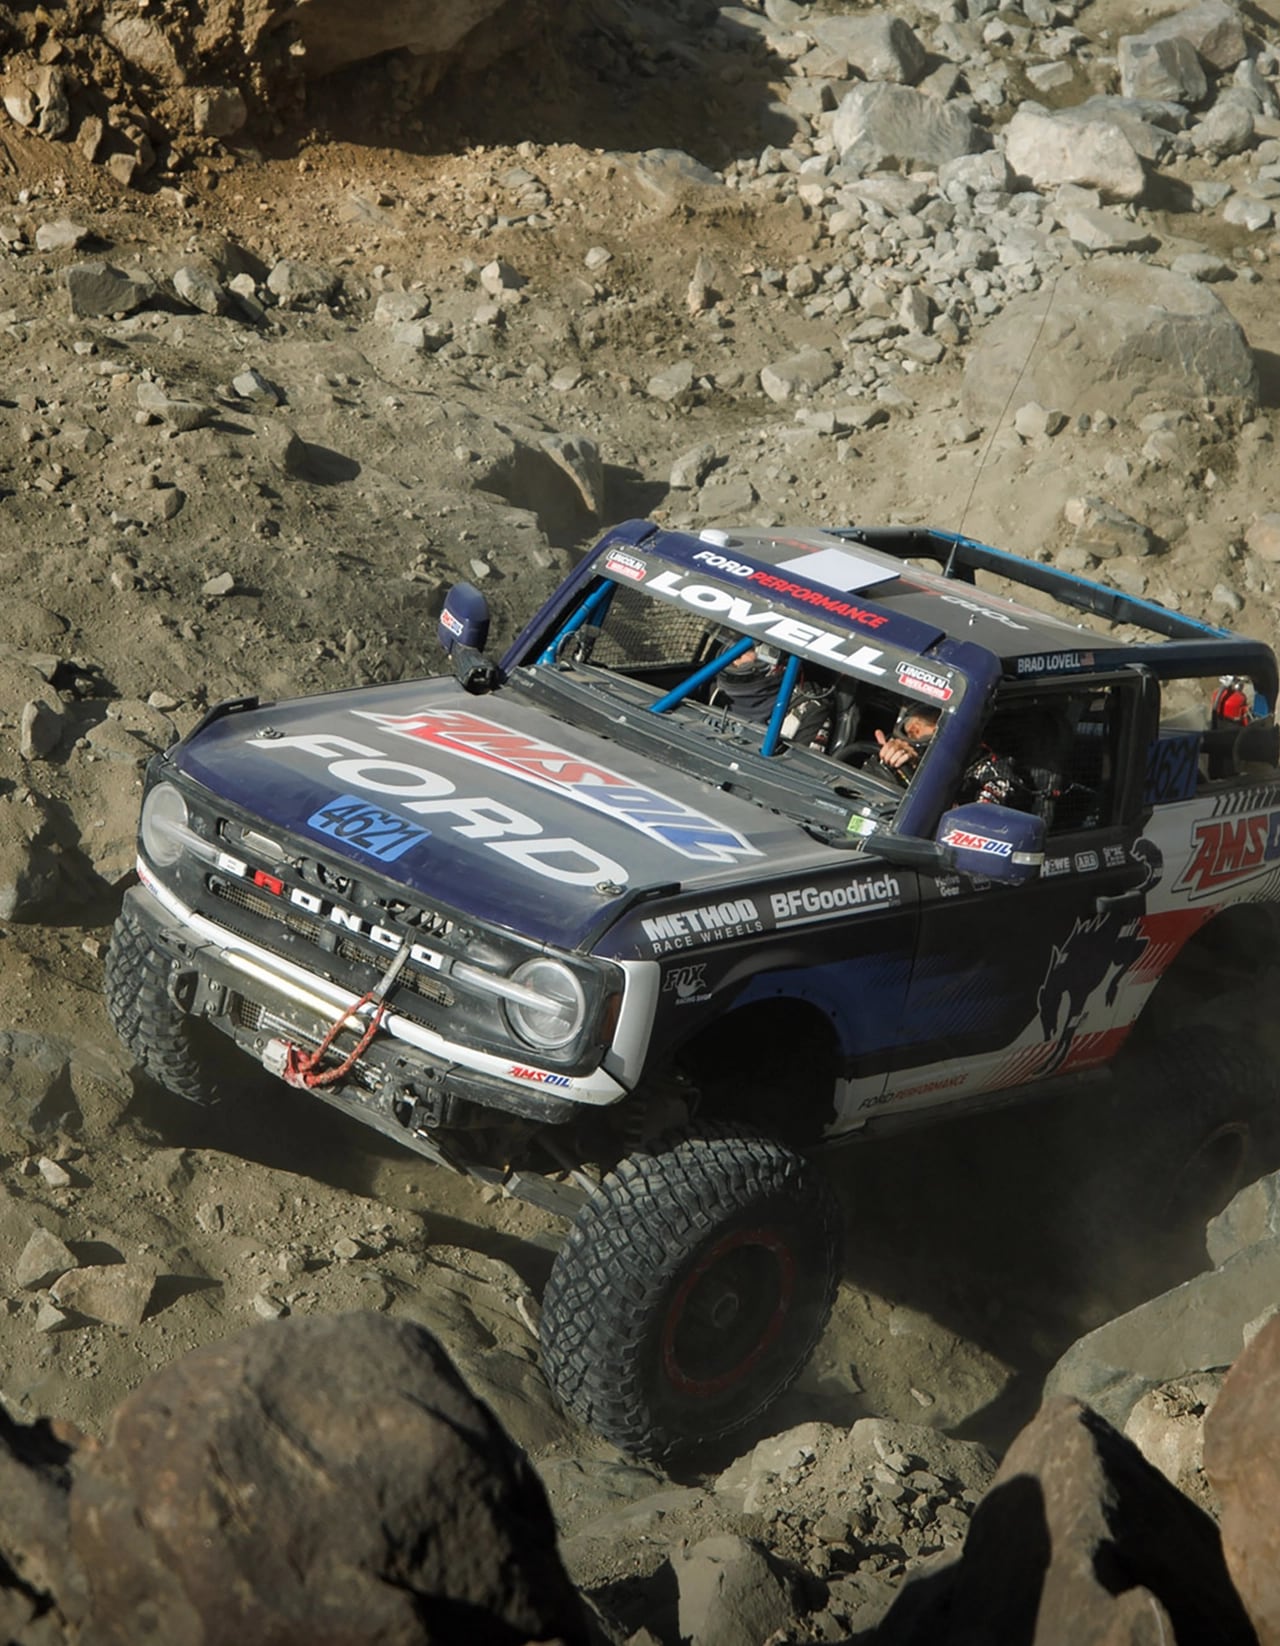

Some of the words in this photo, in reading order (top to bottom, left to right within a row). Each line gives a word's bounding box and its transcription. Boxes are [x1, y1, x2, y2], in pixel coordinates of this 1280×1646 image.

[693, 551, 754, 577] FORD
[747, 571, 889, 629] PERFORMANCE
[645, 570, 887, 676] LOVELL
[899, 665, 947, 689] LINCOLN
[1018, 656, 1045, 673] BRAD
[1046, 653, 1080, 670] LOVELL
[356, 709, 755, 861] AMSOIL
[246, 734, 629, 887] FORD
[317, 798, 421, 856] 4621
[945, 831, 1012, 856] AMSOIL
[217, 851, 442, 972] BRONCO
[770, 873, 900, 920] BFGoodrich
[641, 898, 759, 942] METHOD
[652, 935, 694, 954] RACE
[700, 921, 764, 943] WHEELS
[662, 963, 708, 993] FOX
[506, 1065, 571, 1088] AMSOIL
